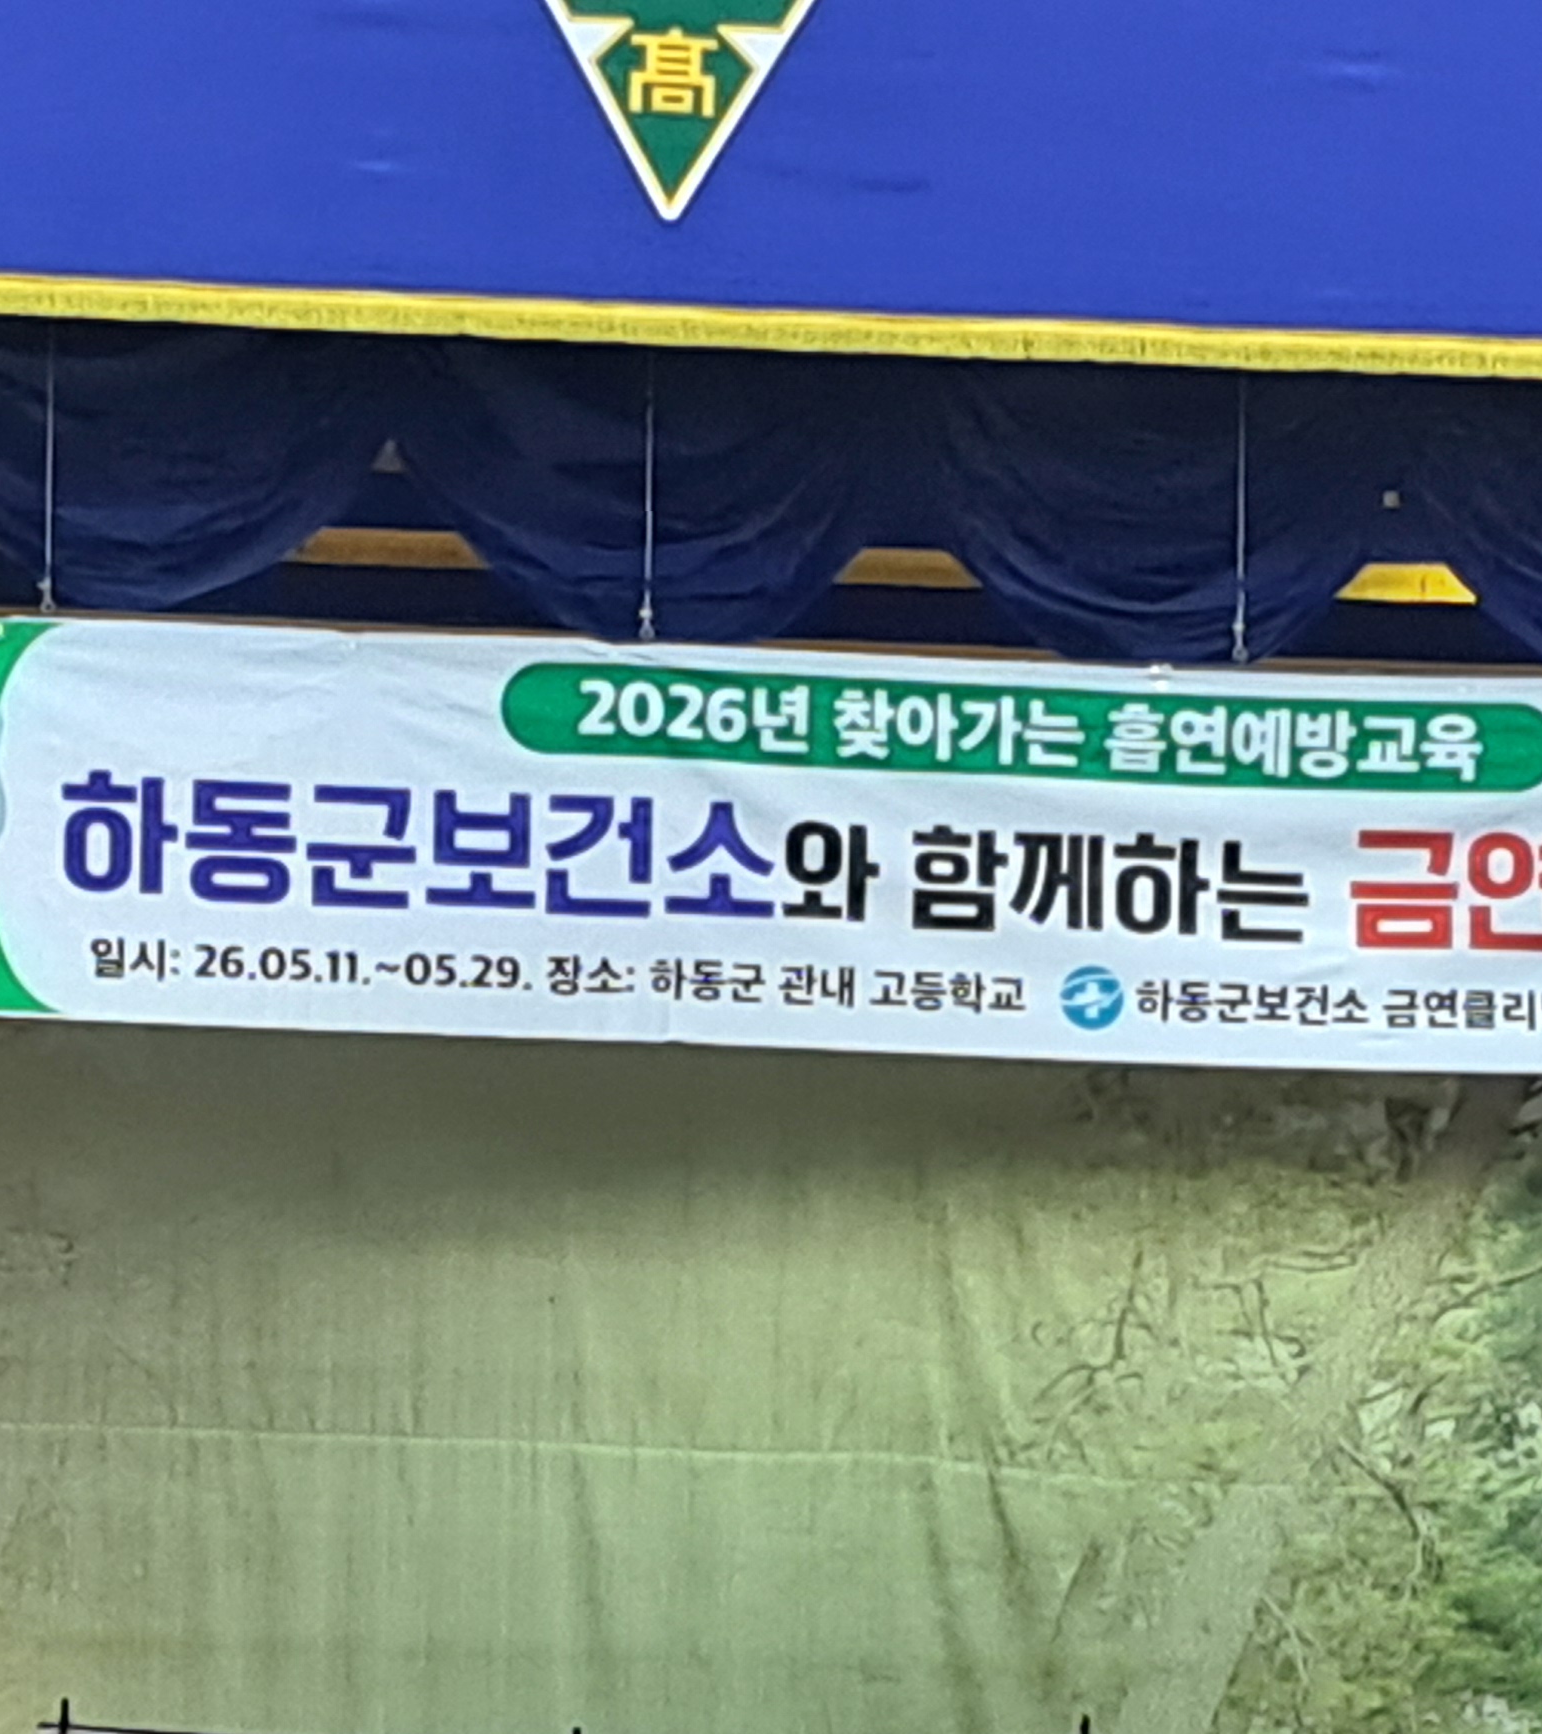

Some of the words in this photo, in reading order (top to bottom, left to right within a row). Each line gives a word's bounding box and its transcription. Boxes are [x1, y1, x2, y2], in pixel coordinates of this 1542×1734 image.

[629, 26, 719, 118] 高
[577, 678, 810, 755] 2026년
[833, 688, 1085, 767] 찾아가는
[1103, 702, 1483, 782] 흡연예방교육
[61, 769, 880, 922] 하동군보건소와
[912, 824, 1310, 943] 함께하는
[90, 938, 180, 982] 일시:
[546, 954, 636, 995] 장소:
[650, 957, 765, 1004] 하동군
[778, 964, 856, 1008] 관내
[869, 969, 1026, 1015] 고등학교
[1135, 980, 1370, 1029] 하동군보건소
